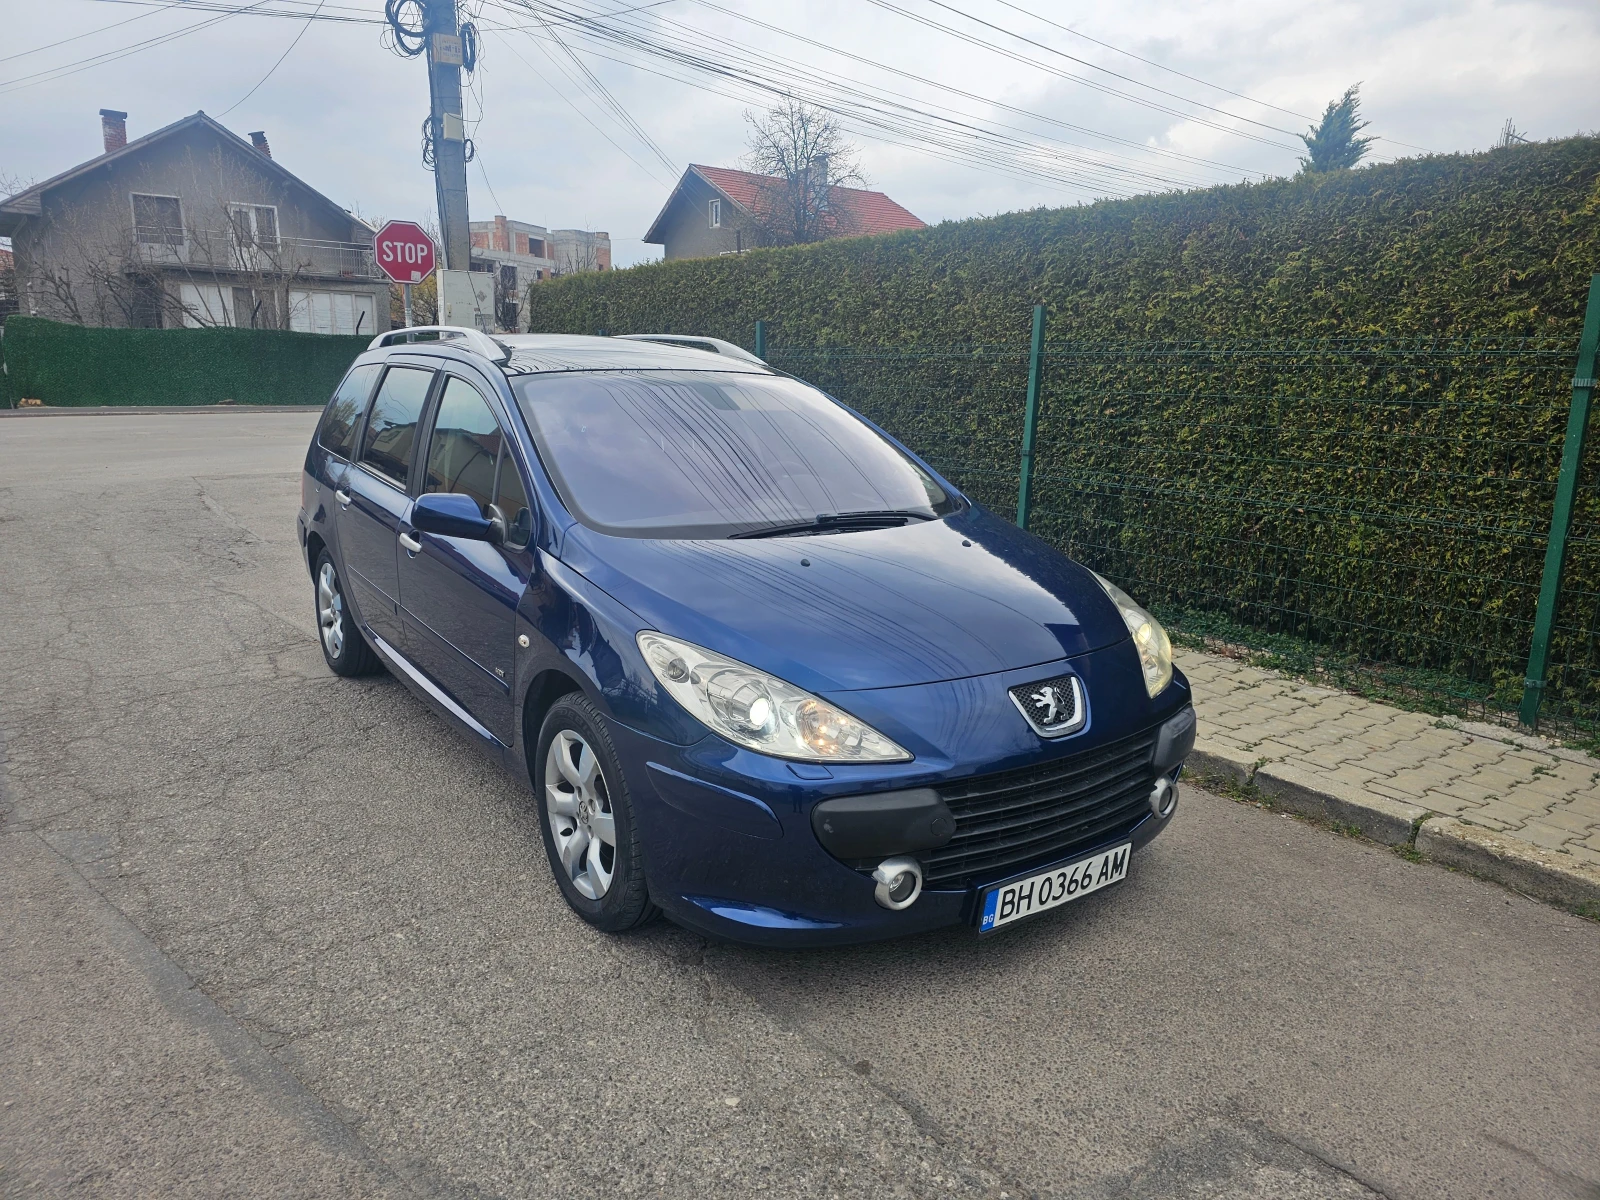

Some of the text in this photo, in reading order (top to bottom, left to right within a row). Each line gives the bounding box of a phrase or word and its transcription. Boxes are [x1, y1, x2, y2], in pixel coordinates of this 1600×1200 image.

[382, 241, 428, 264] STOP
[999, 848, 1127, 920] BH 0366 AM
[982, 913, 994, 925] BG
